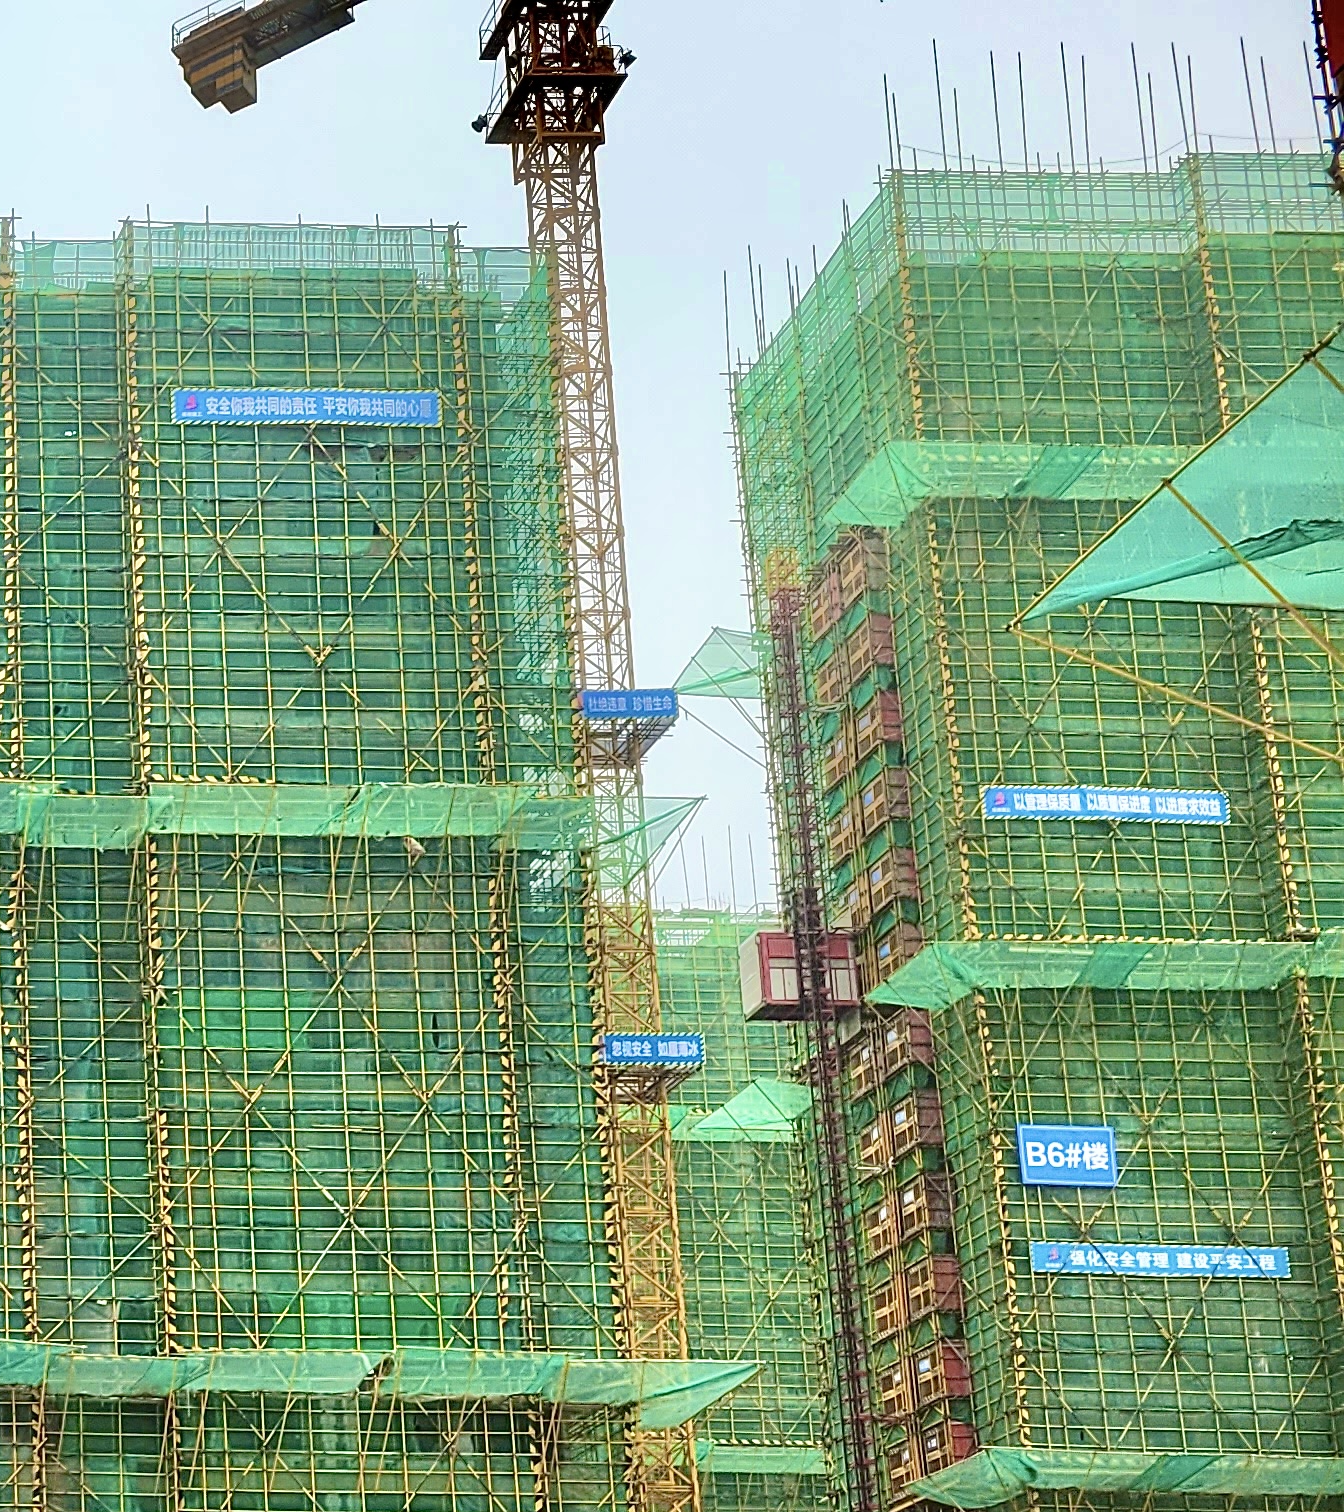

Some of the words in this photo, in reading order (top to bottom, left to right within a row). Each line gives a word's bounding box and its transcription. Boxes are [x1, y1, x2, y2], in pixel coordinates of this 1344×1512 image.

[206, 396, 317, 416] 安全你我共同的责任
[1025, 1141, 1110, 1173] B6#楼
[1069, 1250, 1169, 1271] 强化安全管理
